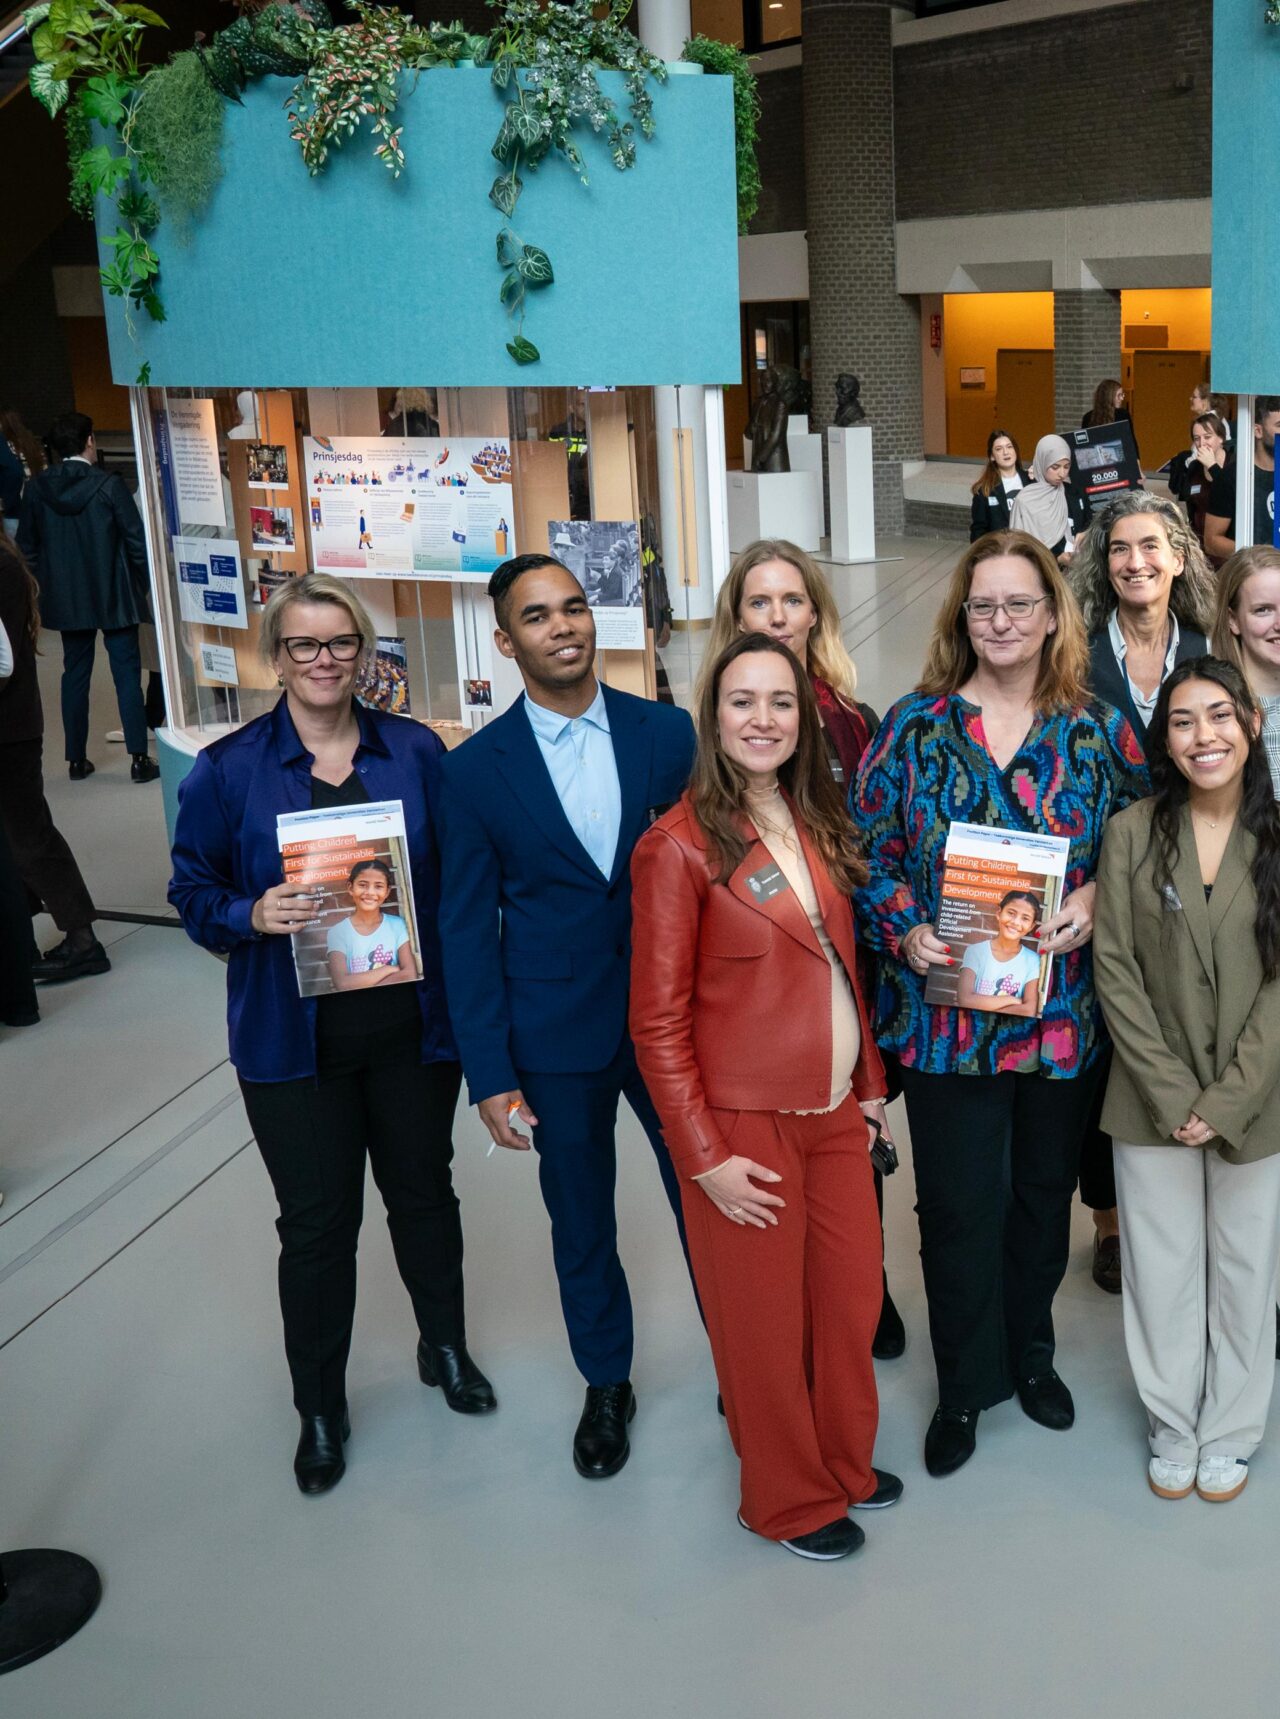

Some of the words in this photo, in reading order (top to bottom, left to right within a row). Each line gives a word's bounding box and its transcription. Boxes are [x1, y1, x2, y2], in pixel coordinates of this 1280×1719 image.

[313, 451, 363, 463] Prinsjesdag
[284, 843, 315, 853] Putting
[318, 837, 356, 848] Children
[286, 859, 306, 868] First
[323, 849, 374, 863] Sustainable
[948, 855, 979, 869] Putting
[981, 859, 1018, 872] Children
[946, 871, 965, 881] First
[967, 872, 981, 882] for
[982, 875, 1030, 888] Sustainable
